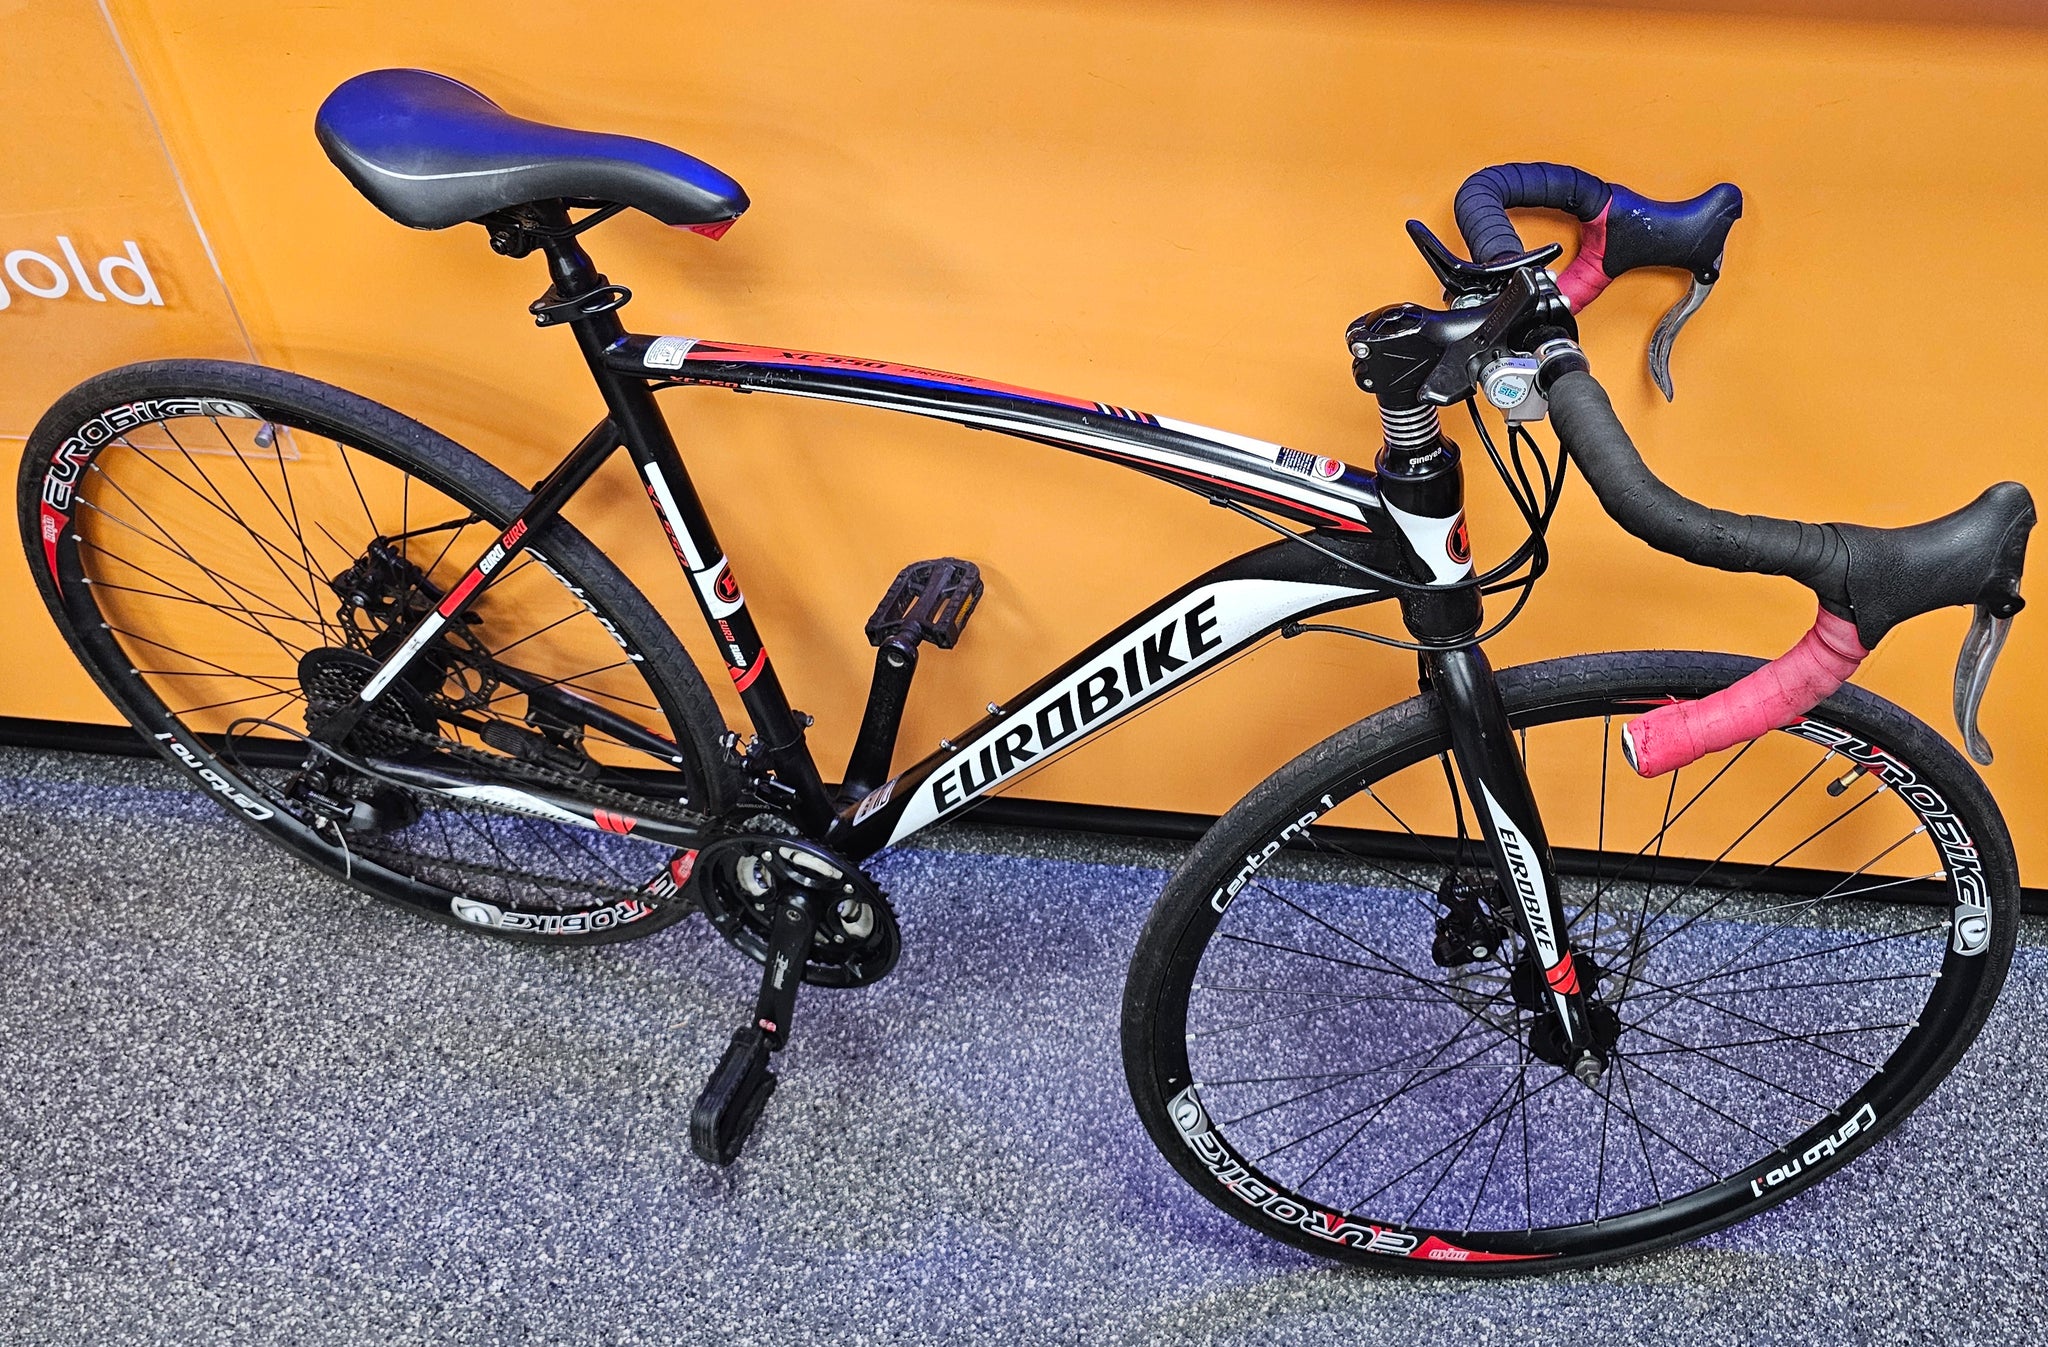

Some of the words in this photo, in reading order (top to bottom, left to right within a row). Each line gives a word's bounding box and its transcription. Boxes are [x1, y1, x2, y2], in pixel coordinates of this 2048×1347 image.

[0, 236, 164, 310] old
[42, 398, 202, 509] EUROBIKE
[479, 543, 506, 575] EURO
[502, 518, 528, 550] EURO
[718, 619, 736, 642] EURO
[729, 643, 748, 667] EURO
[932, 594, 1223, 815] EUROBIKE
[1785, 720, 1988, 912] EUROBIKE
[501, 871, 679, 936] EROBIKE
[1498, 826, 1556, 952] EUROBIKE
[1189, 1130, 1419, 1256] EUROBIKE
